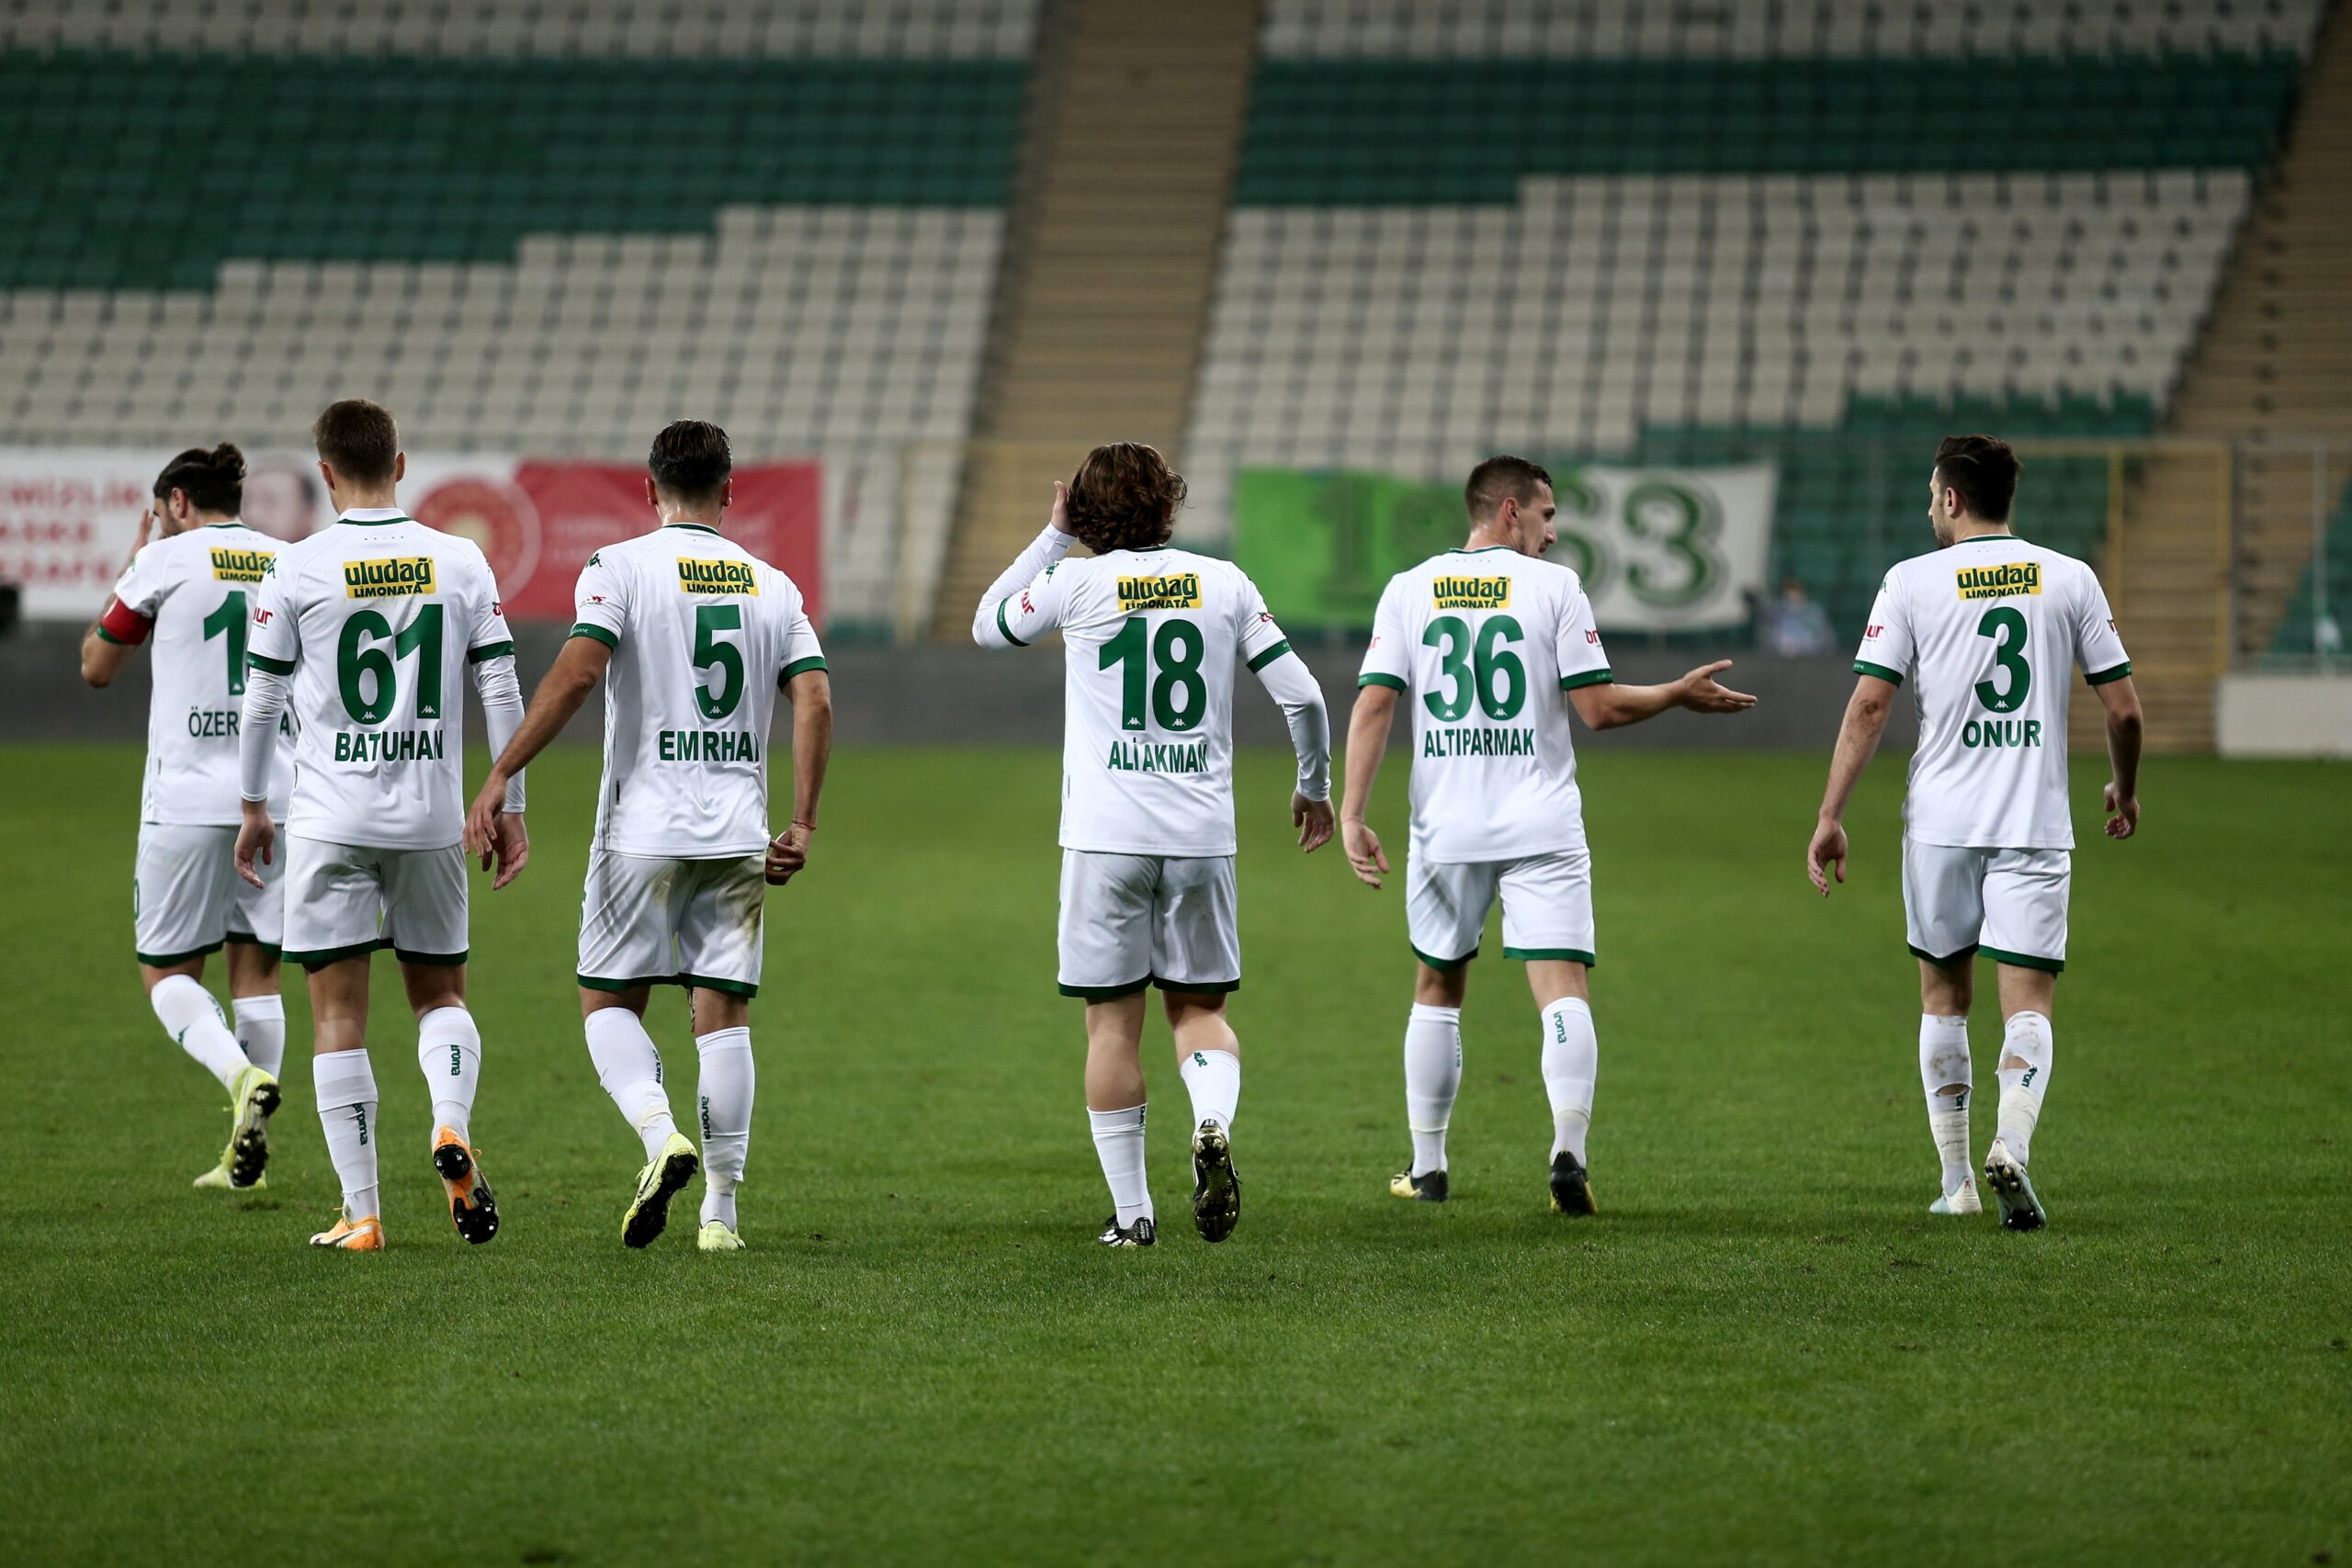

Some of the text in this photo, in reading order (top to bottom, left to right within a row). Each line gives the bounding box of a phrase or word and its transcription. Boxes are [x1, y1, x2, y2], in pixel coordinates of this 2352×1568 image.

[211, 549, 270, 571] uluda
[345, 558, 432, 586] uludağ
[678, 559, 755, 588] uludağ
[1957, 562, 2038, 589] uludağ
[1118, 573, 1198, 600] uludağ
[1433, 576, 1508, 601] uludağ
[204, 591, 247, 695] 1
[1974, 606, 2031, 713] 3
[337, 604, 443, 725] 61
[693, 604, 744, 719] 5
[1099, 616, 1207, 732] 18
[1422, 615, 1527, 721] 36
[188, 705, 240, 738] ÖZER
[1962, 719, 2041, 749] ONUR
[334, 729, 443, 762] BATUHAN
[1108, 737, 1209, 773] ALİ AKMAN
[1424, 728, 1535, 758] ALTIPARMAK
